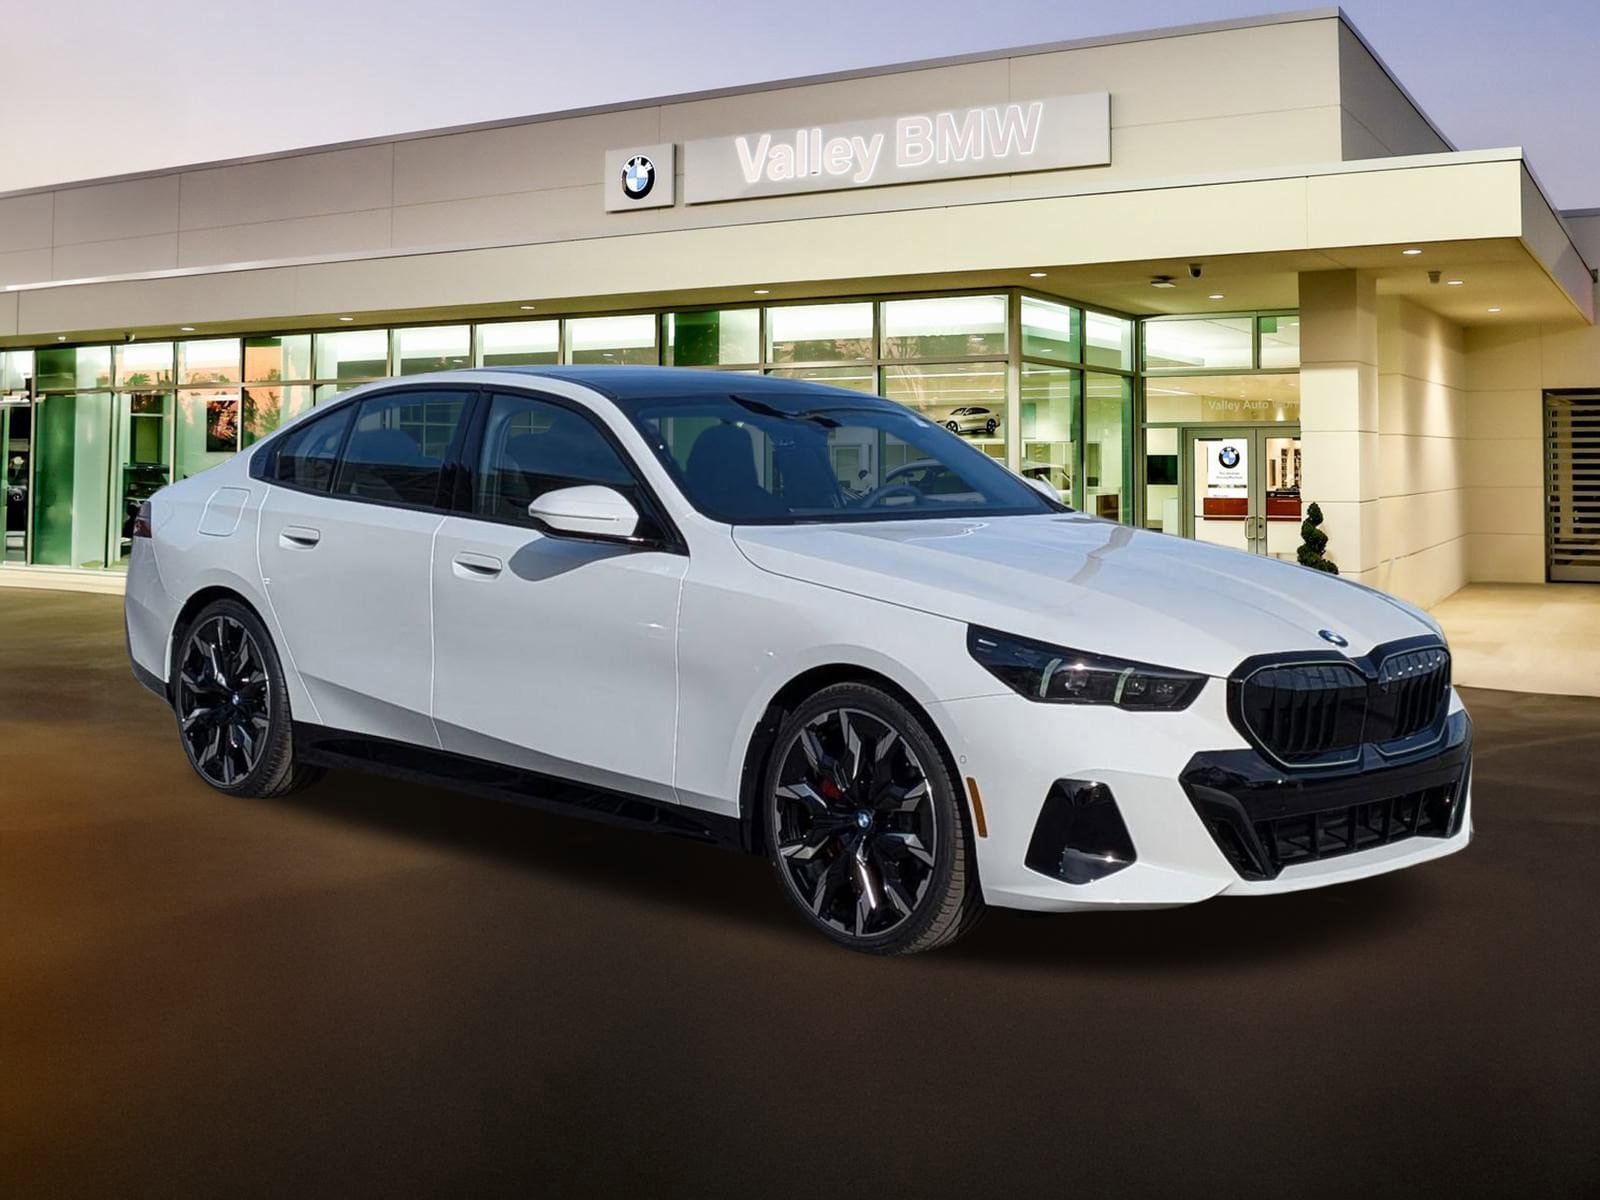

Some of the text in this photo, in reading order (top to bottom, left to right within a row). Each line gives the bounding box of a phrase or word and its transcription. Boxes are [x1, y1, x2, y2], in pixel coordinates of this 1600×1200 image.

[735, 102, 1043, 183] Valley BMW
[1208, 400, 1240, 412] Valley
[1243, 400, 1269, 409] Auto
